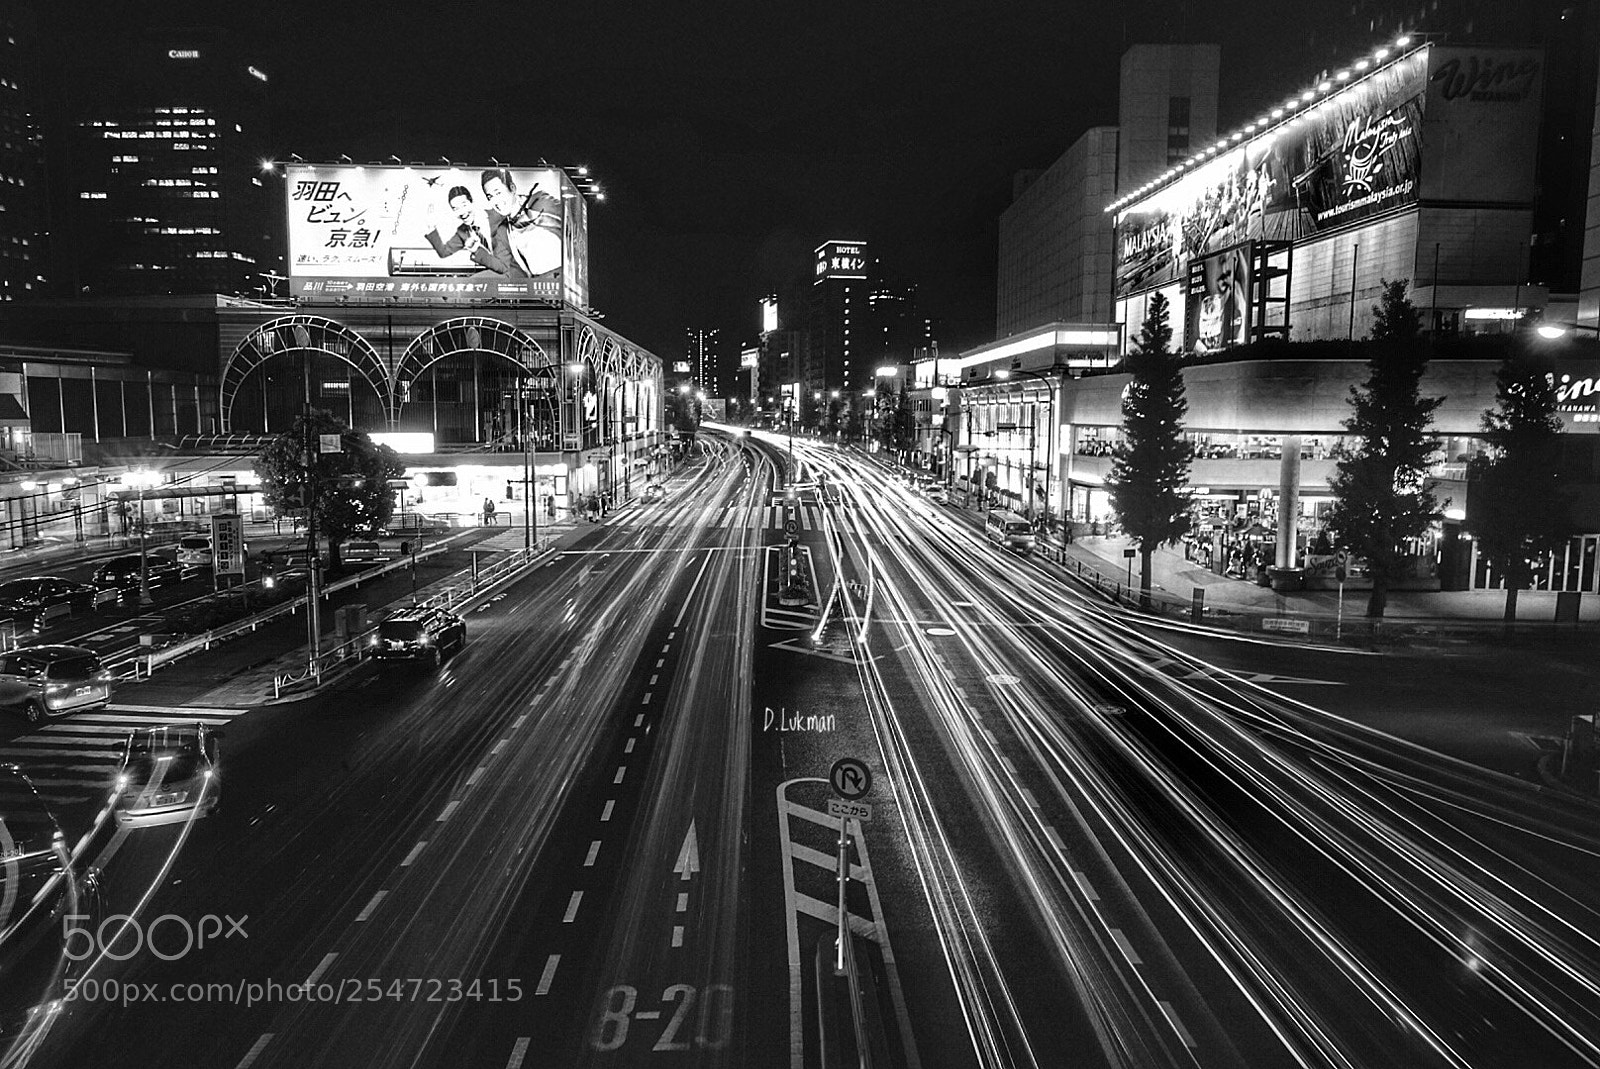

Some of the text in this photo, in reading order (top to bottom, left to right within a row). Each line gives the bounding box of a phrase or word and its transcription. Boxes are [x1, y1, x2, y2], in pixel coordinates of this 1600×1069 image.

[168, 50, 199, 58] Canon
[1341, 109, 1407, 153] Malaysia
[292, 181, 352, 201] 羽田へ
[1317, 179, 1414, 221] www.tourismmalaysia.or.jp
[306, 203, 368, 226] ビュン。
[324, 228, 381, 249] 京急！
[1123, 222, 1166, 259] MALAYSIA
[836, 246, 860, 254] HOTEL
[831, 256, 865, 270] 東横イン
[303, 282, 324, 291] 品川
[356, 282, 395, 291] 羽田空港
[831, 803, 869, 818] ここから
[590, 983, 735, 1052] 8-20
